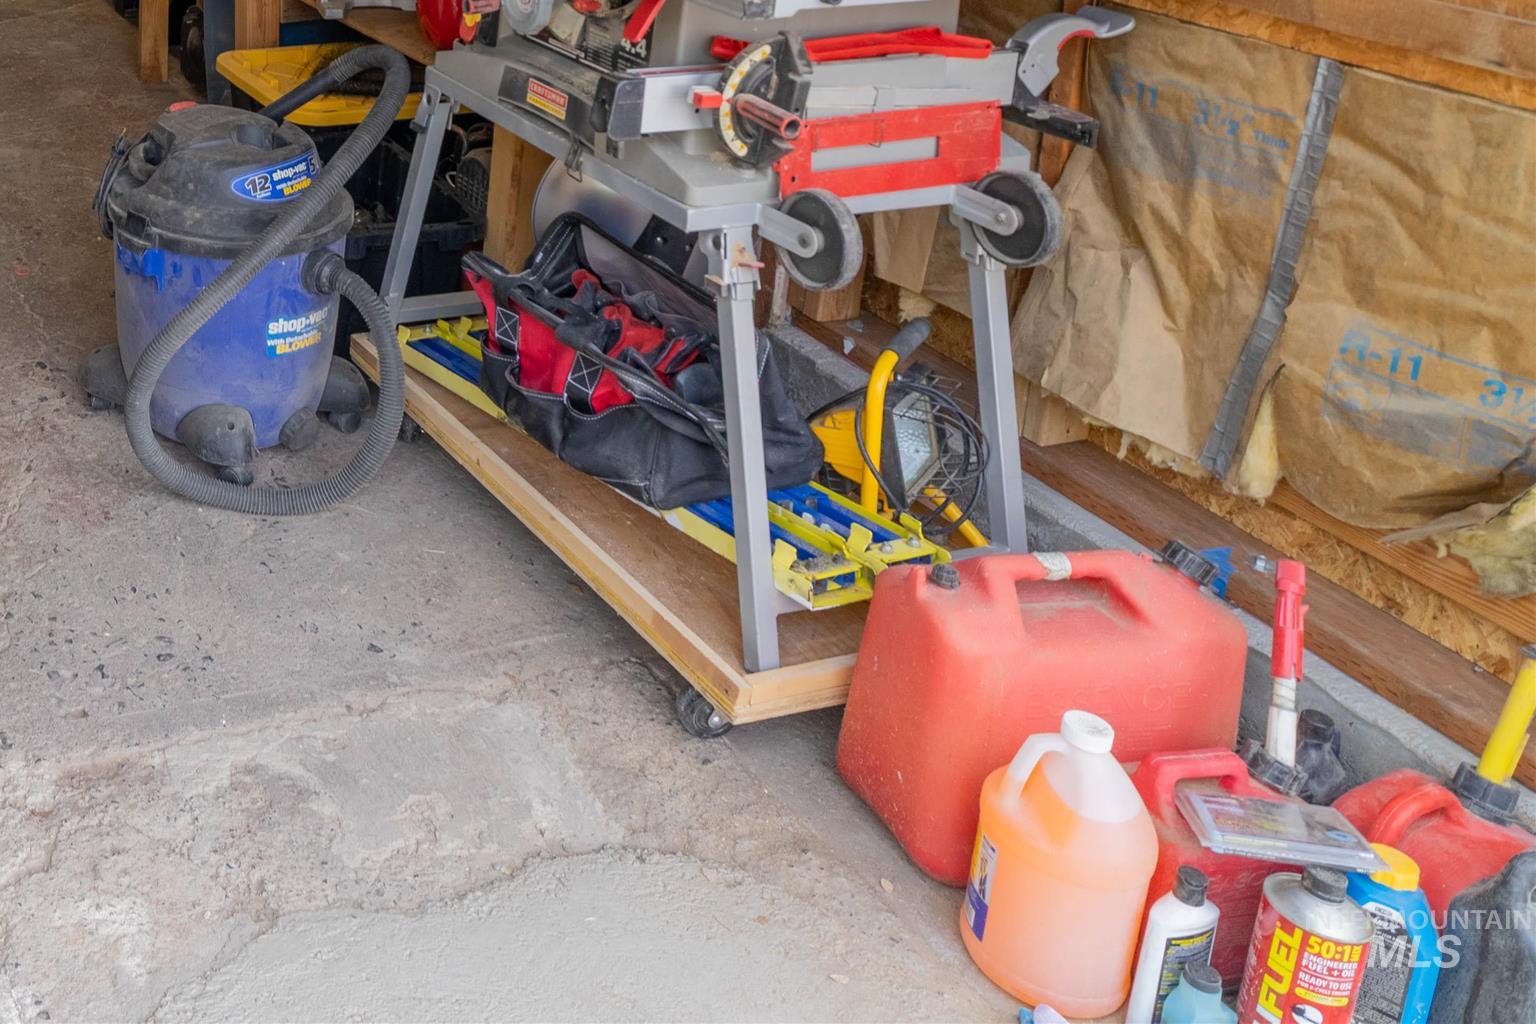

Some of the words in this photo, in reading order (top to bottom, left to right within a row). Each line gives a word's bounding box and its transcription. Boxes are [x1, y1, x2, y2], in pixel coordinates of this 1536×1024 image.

[245, 173, 272, 195] 12
[268, 307, 328, 335] shop-vac
[276, 331, 321, 355] BLOWER
[1305, 935, 1353, 962] 50:1
[1301, 958, 1329, 976] FUEL
[1330, 968, 1340, 977] +
[1303, 951, 1359, 970] ENGINEERED
[1251, 925, 1304, 1024] FUEL
[1298, 971, 1328, 988] READY
[1328, 980, 1338, 989] TO
[1339, 980, 1353, 991] USE
